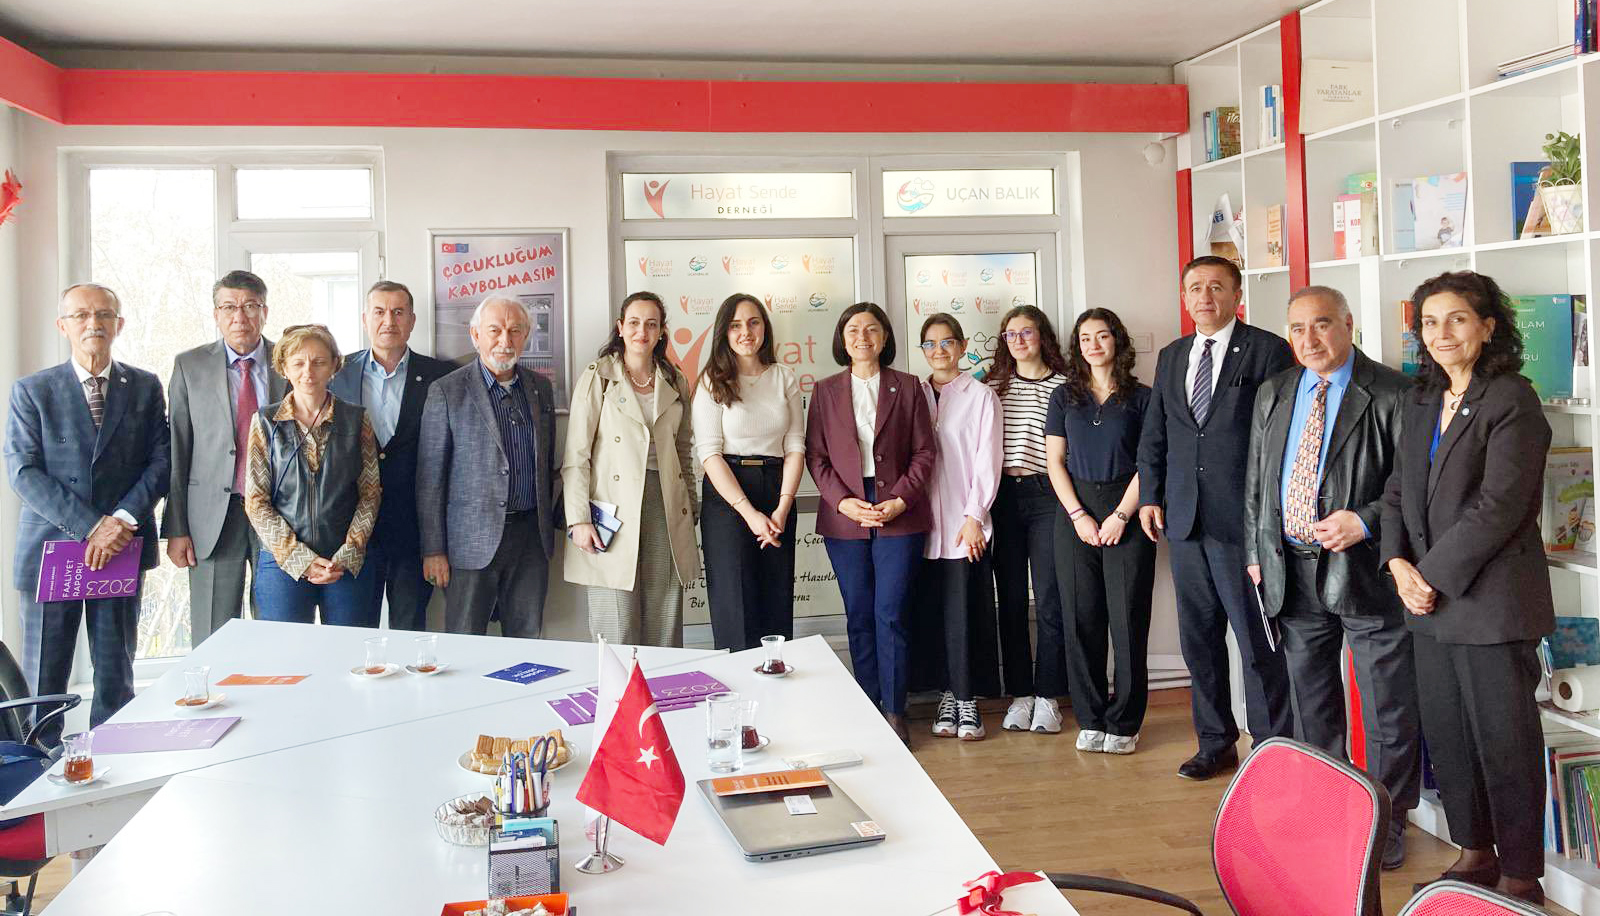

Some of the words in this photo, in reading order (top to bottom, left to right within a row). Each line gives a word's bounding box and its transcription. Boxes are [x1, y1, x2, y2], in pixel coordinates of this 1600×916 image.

[691, 184, 743, 204] Hayat
[749, 184, 798, 199] Sende
[946, 187, 990, 203] UÇAN
[995, 186, 1040, 200] BALIK
[717, 205, 773, 214] DERNEĞİ
[442, 245, 553, 281] ÇOCUKLUĞUM
[448, 265, 556, 300] KAYBOLMASIN
[63, 559, 75, 598] FAALİYET
[72, 562, 84, 597] RAPORU
[800, 571, 837, 582] Hazırla
[86, 578, 135, 596] 2023
[689, 596, 705, 608] Bir
[661, 682, 724, 696] 2023
